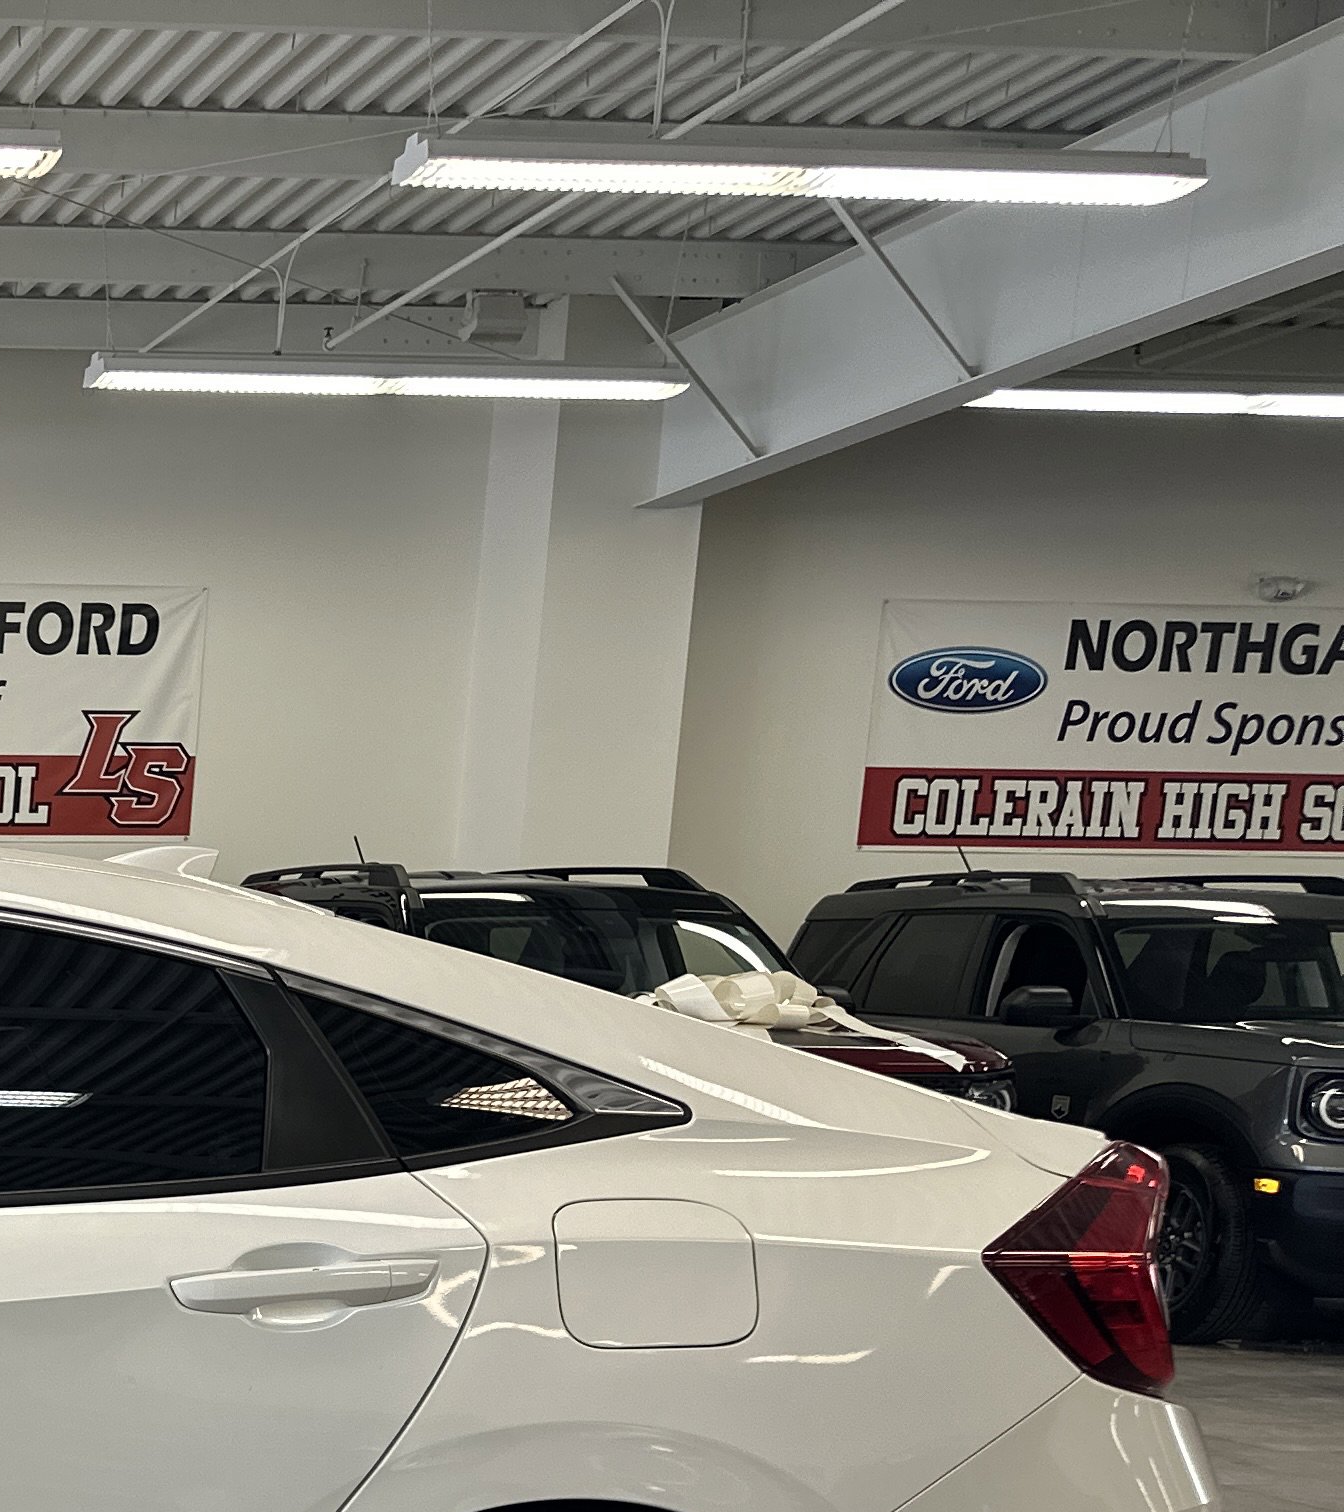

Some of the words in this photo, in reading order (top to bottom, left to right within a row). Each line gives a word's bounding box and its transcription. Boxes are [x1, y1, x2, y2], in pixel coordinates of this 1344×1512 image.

[916, 656, 1019, 703] Ford
[1056, 699, 1202, 745] Proud
[891, 777, 1146, 838] COLERAIN
[1156, 781, 1290, 841] HIGH
